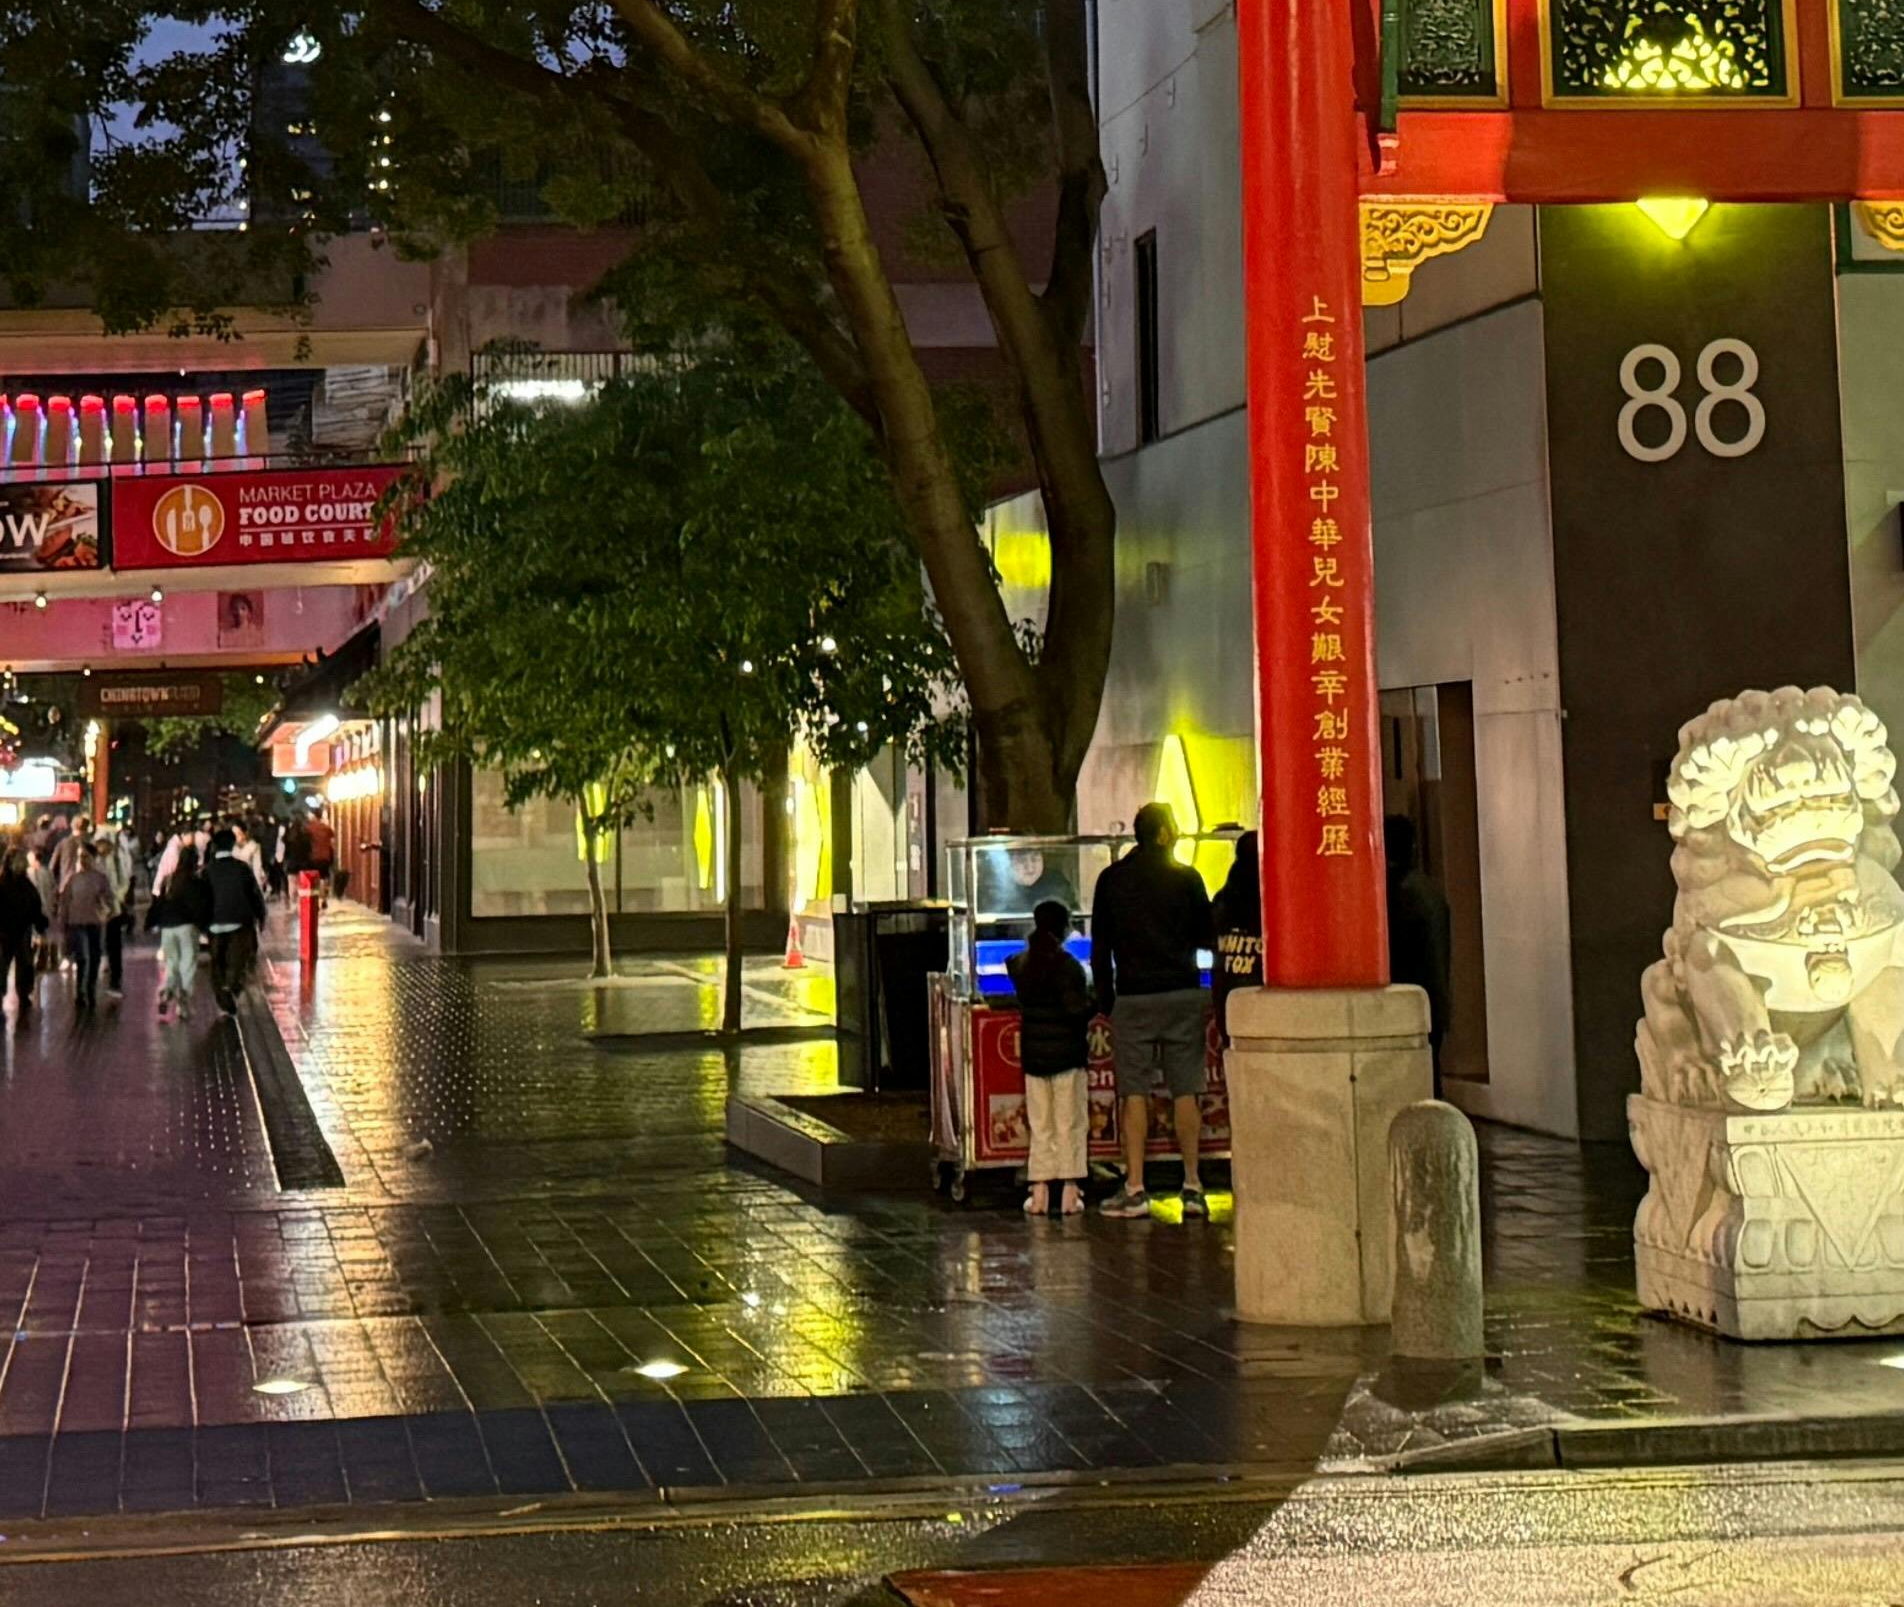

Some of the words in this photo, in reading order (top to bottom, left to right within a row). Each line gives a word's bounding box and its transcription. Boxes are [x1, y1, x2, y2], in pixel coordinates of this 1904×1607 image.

[1617, 337, 1766, 462] 88
[239, 484, 313, 504] MARKET
[319, 482, 378, 498] PLAZA
[239, 505, 299, 526] FOOD
[306, 502, 375, 521] COURT
